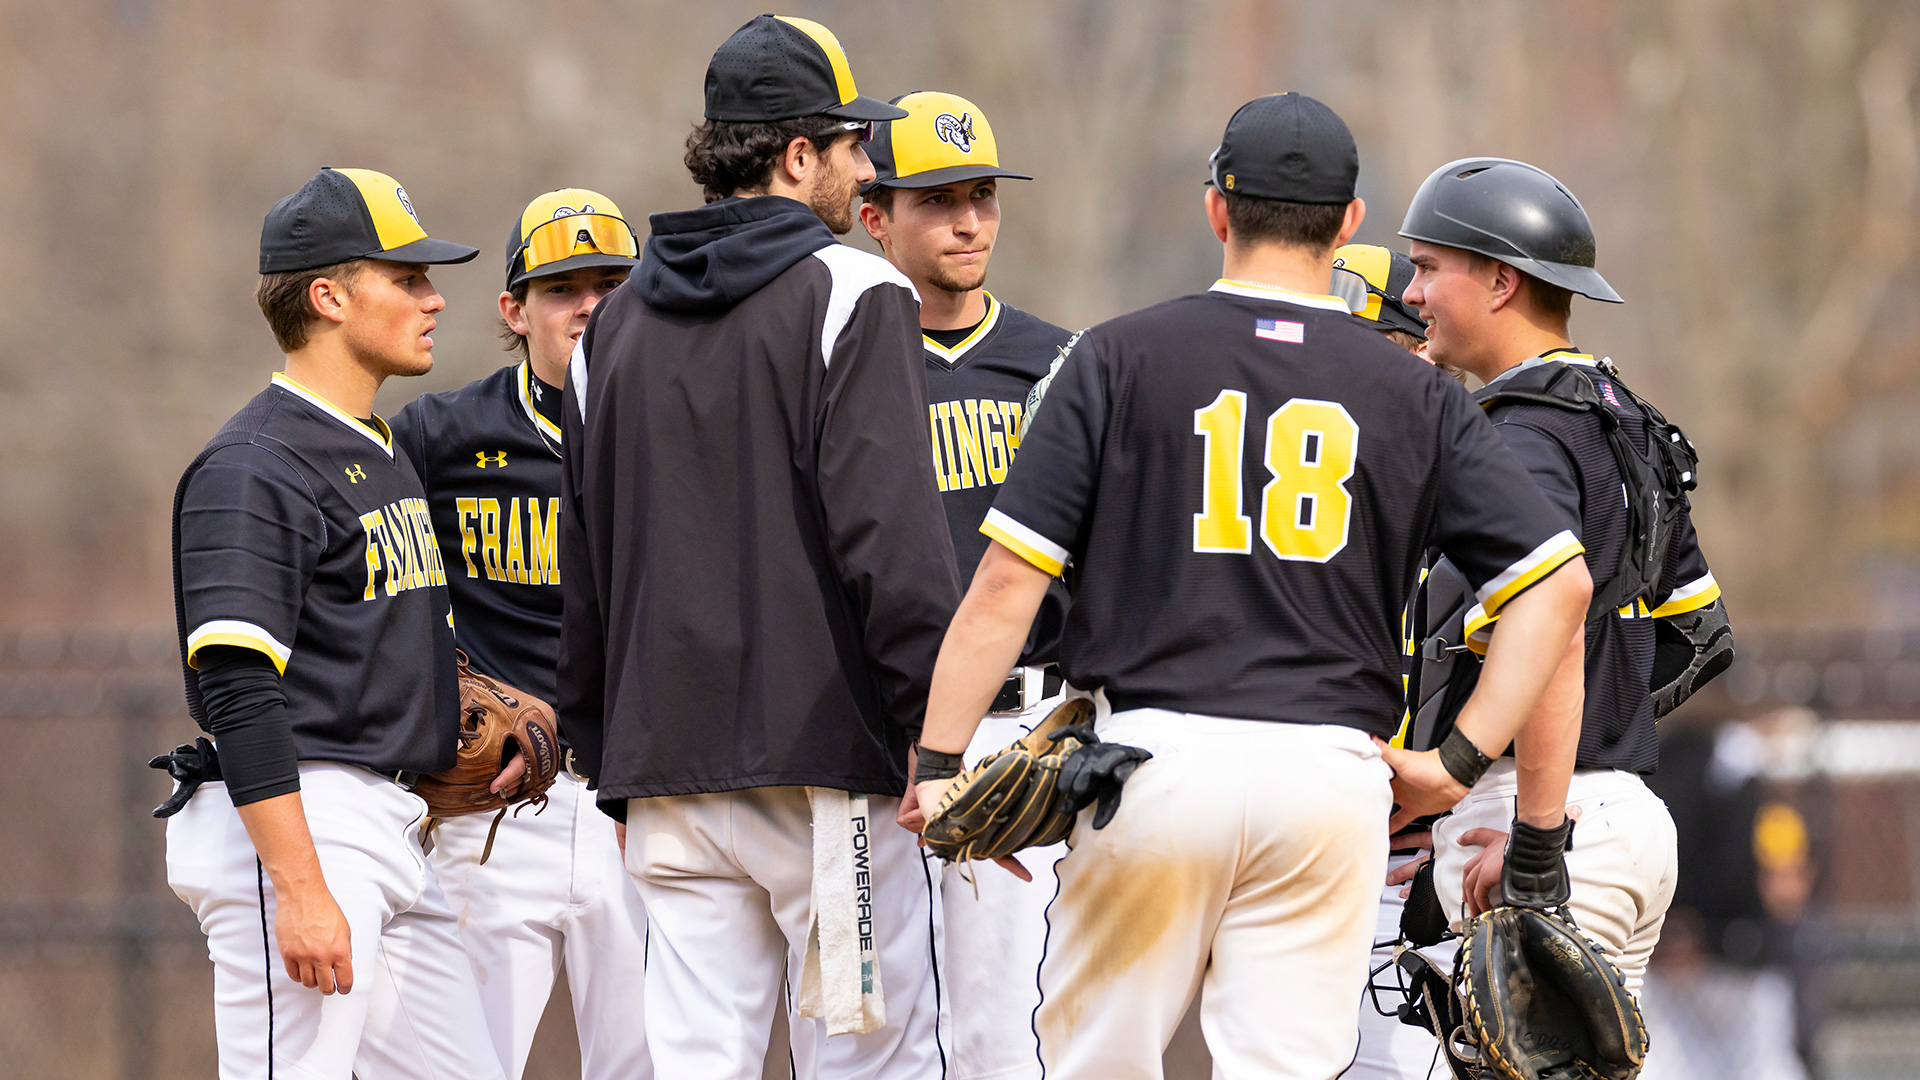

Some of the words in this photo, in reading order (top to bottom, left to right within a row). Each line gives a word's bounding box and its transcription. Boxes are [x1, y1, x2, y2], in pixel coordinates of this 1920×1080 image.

[1193, 388, 1360, 564] 18
[455, 497, 563, 585] FRAM
[531, 724, 552, 777] Wilson
[851, 815, 873, 951] POWERADE
